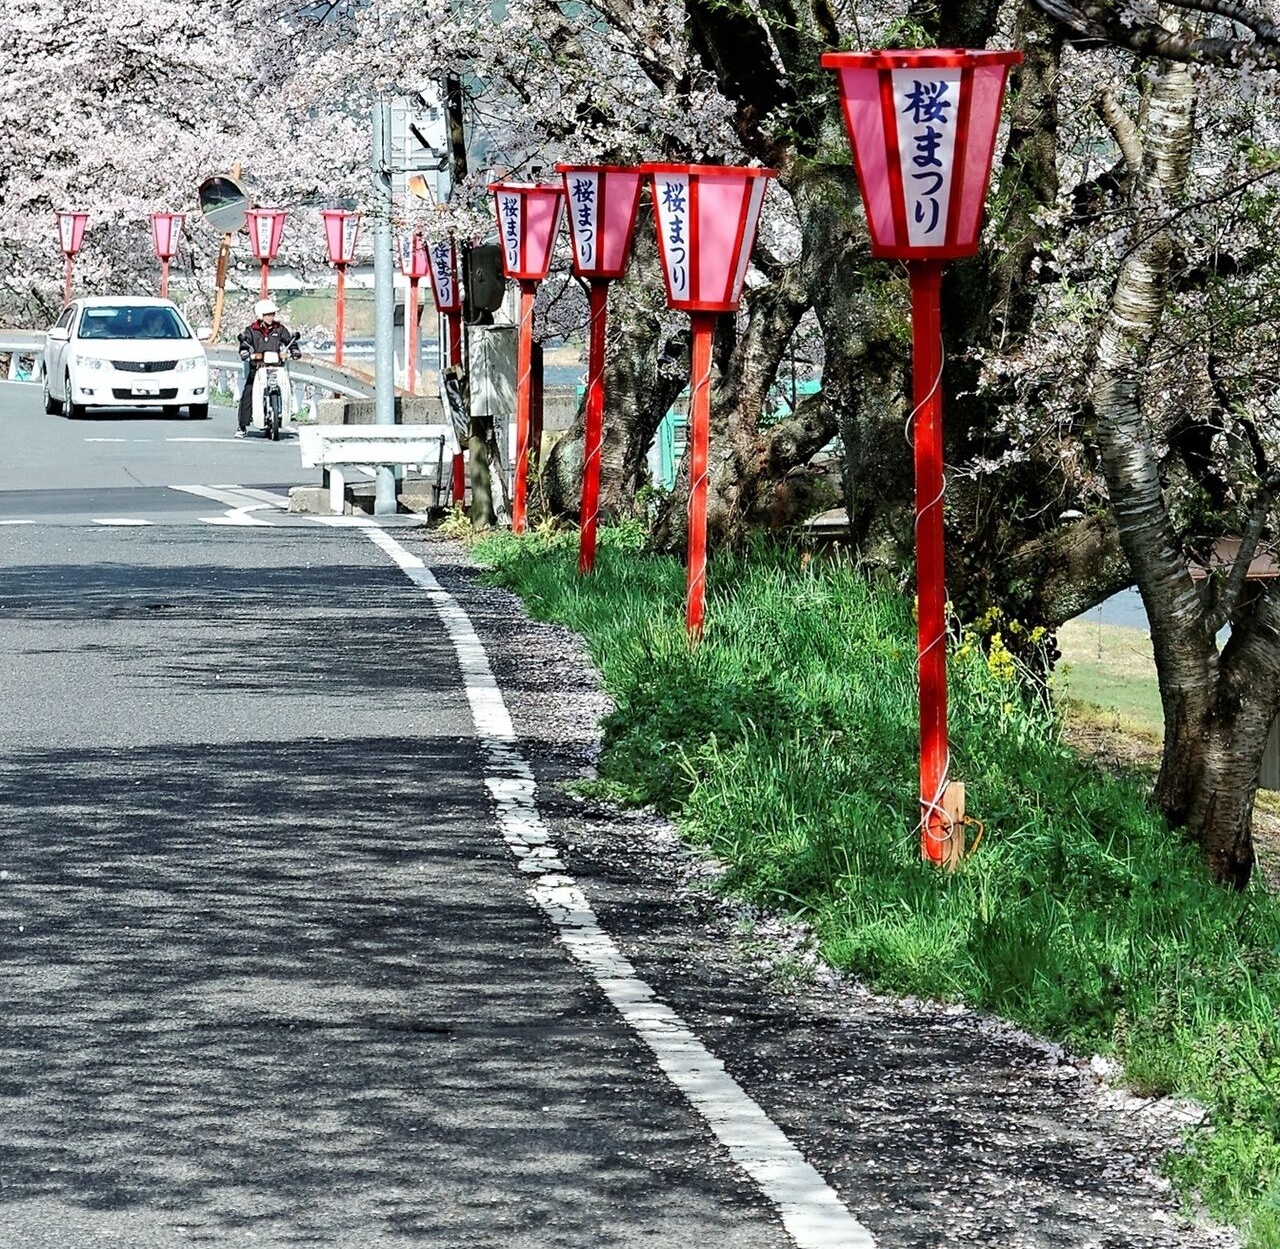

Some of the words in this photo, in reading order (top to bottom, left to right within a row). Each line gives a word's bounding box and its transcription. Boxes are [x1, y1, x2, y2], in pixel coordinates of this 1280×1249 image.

[901, 80, 952, 234] 桜まつり
[344, 219, 357, 257] 桜まつり
[502, 197, 519, 267] 桜まつり
[572, 179, 595, 264] 桜まつり
[662, 181, 686, 292] 桜まつり
[432, 241, 453, 302] 桜まつり
